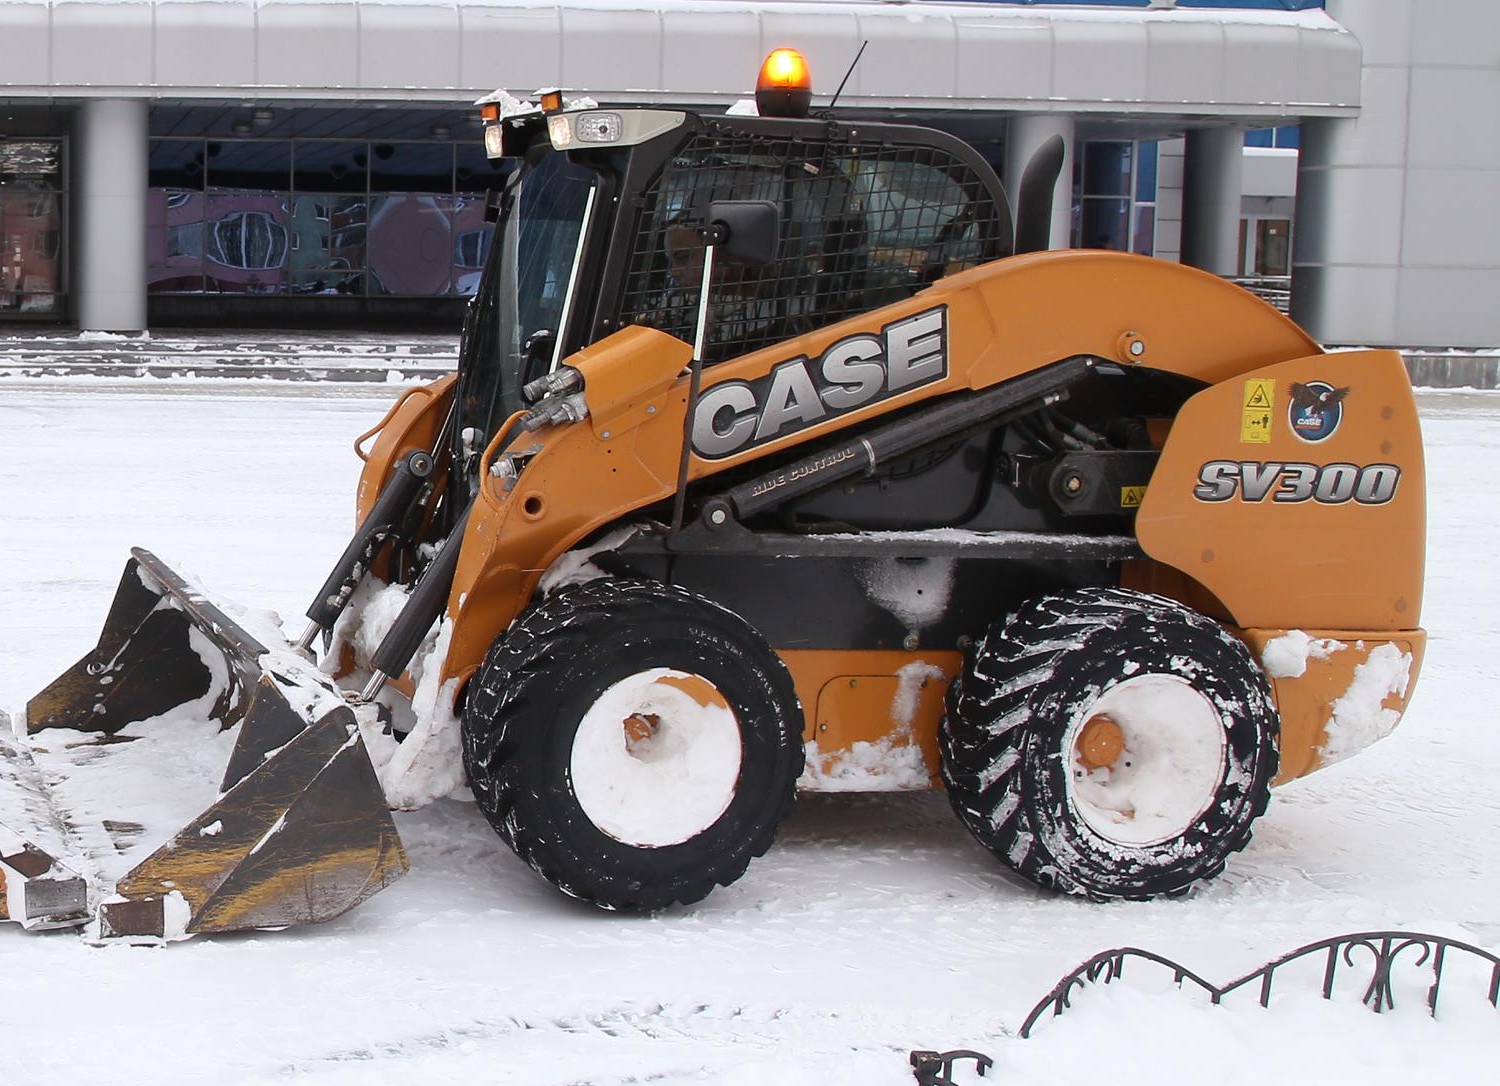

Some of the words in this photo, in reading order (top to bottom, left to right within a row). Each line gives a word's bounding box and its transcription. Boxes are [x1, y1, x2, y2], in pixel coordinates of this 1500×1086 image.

[690, 310, 944, 458] CASE
[1296, 418, 1322, 426] CASE
[1193, 459, 1401, 505] SV300
